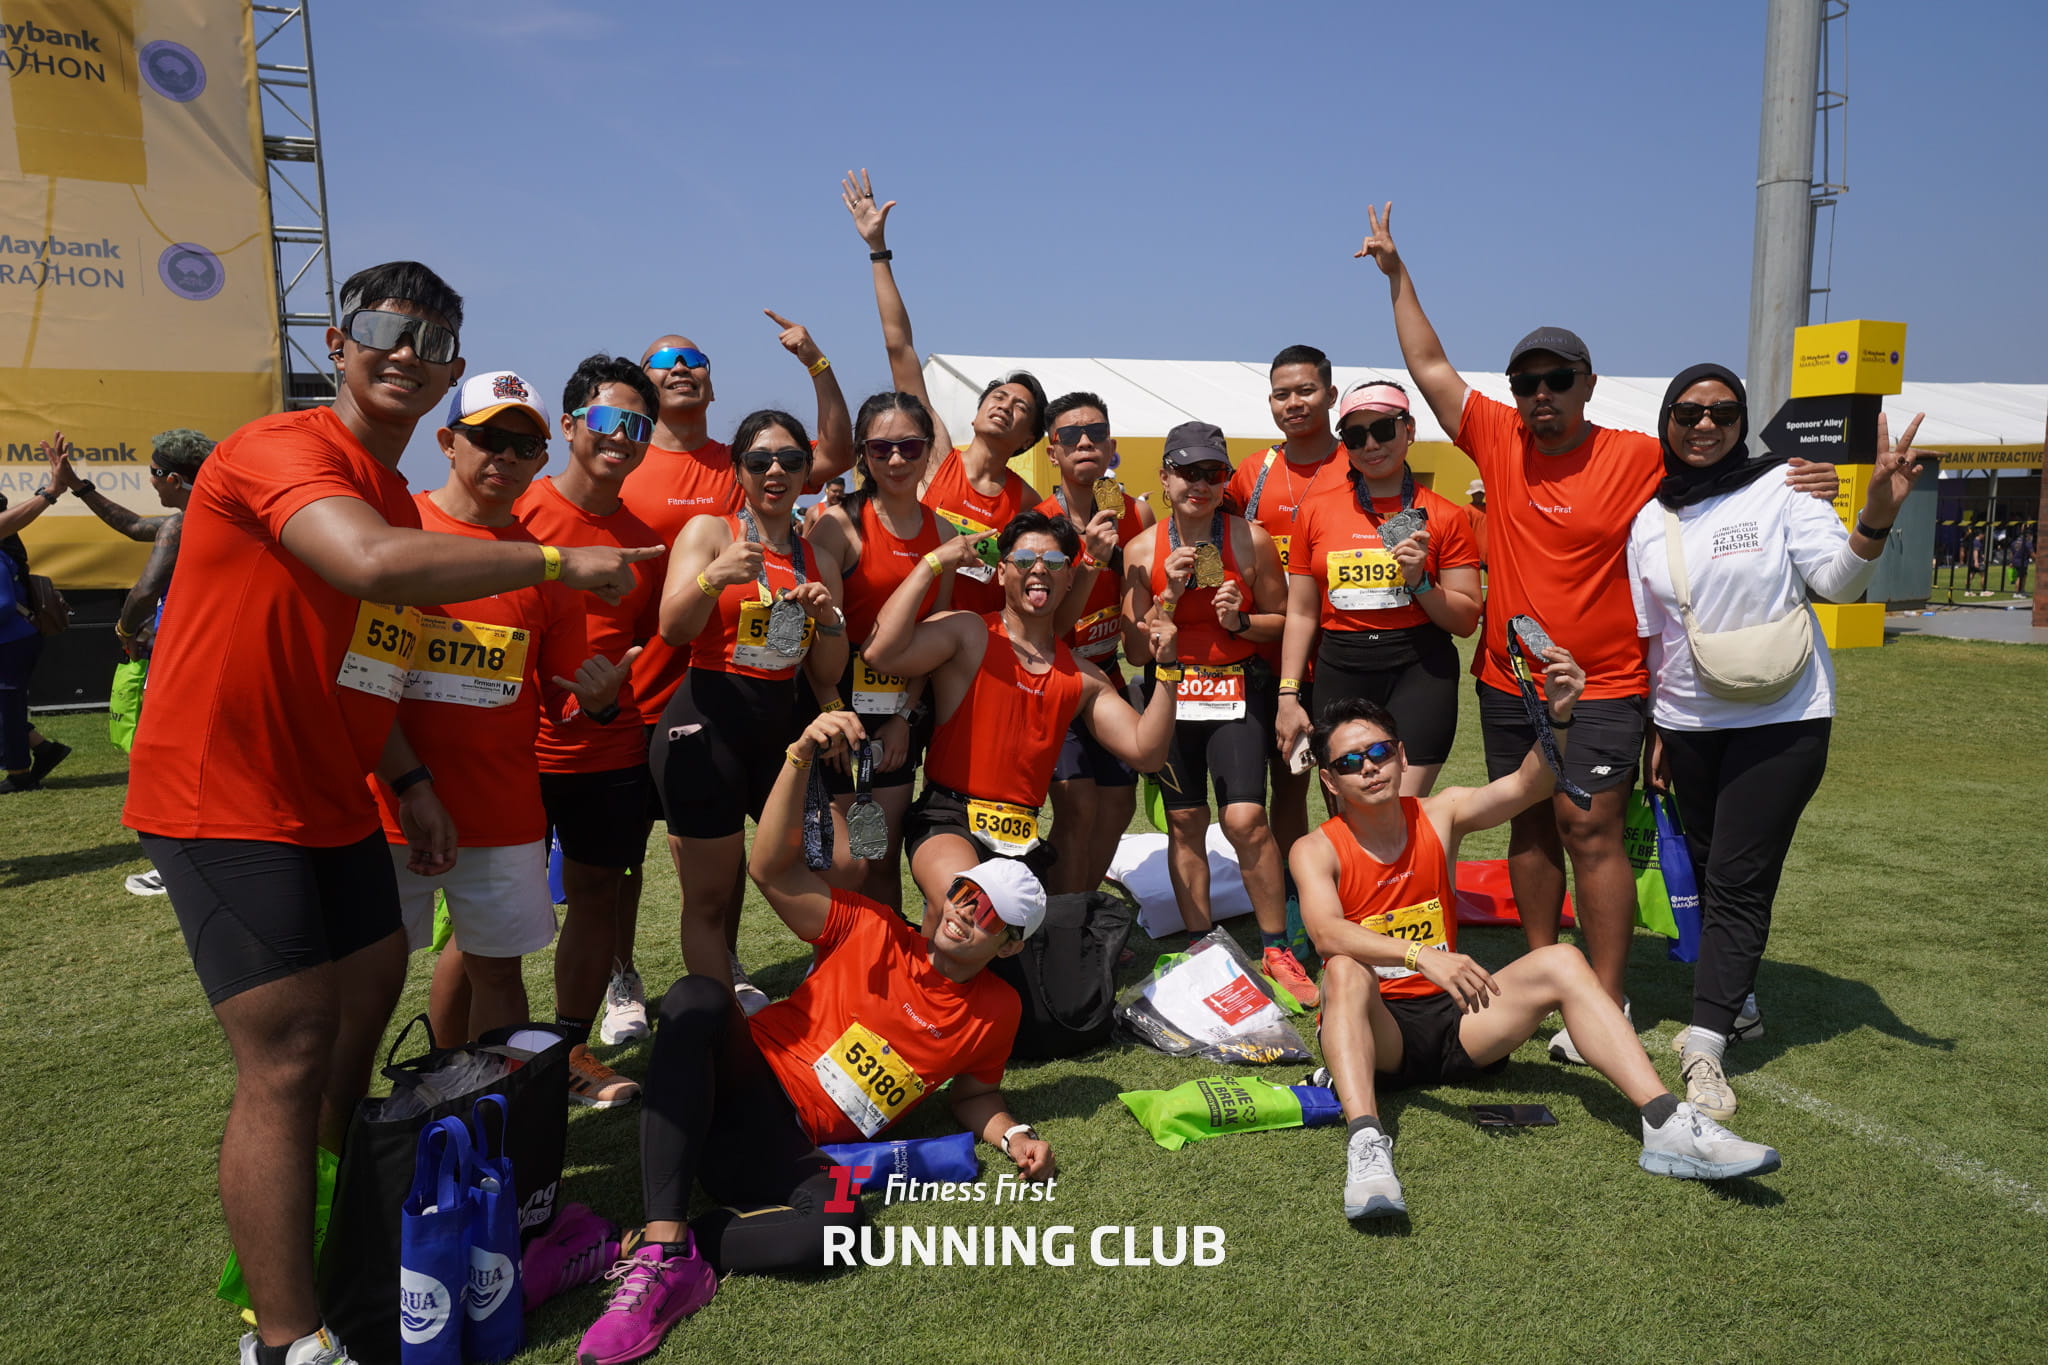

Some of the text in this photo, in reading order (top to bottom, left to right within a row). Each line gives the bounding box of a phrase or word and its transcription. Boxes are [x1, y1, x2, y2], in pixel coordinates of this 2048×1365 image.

[1824, 418, 1844, 428] Alley
[1800, 434, 1842, 444] Main Stage
[1976, 451, 2044, 464] INTERACTIVE
[696, 496, 715, 504] First
[1553, 505, 1572, 513] First
[1713, 532, 1759, 545] 42.195K
[1714, 540, 1759, 553] FINISHER
[1339, 564, 1397, 582] 53193
[1395, 587, 1402, 596] F
[428, 638, 507, 671] 61718
[502, 683, 517, 697] M
[1177, 679, 1236, 696] 30241
[976, 812, 1032, 839] 53036
[1427, 901, 1440, 911] CC
[902, 1002, 943, 1039] Fitness First
[845, 1042, 906, 1107] 53180
[1231, 1087, 1254, 1106] ME
[1213, 1086, 1240, 1125] BREAK
